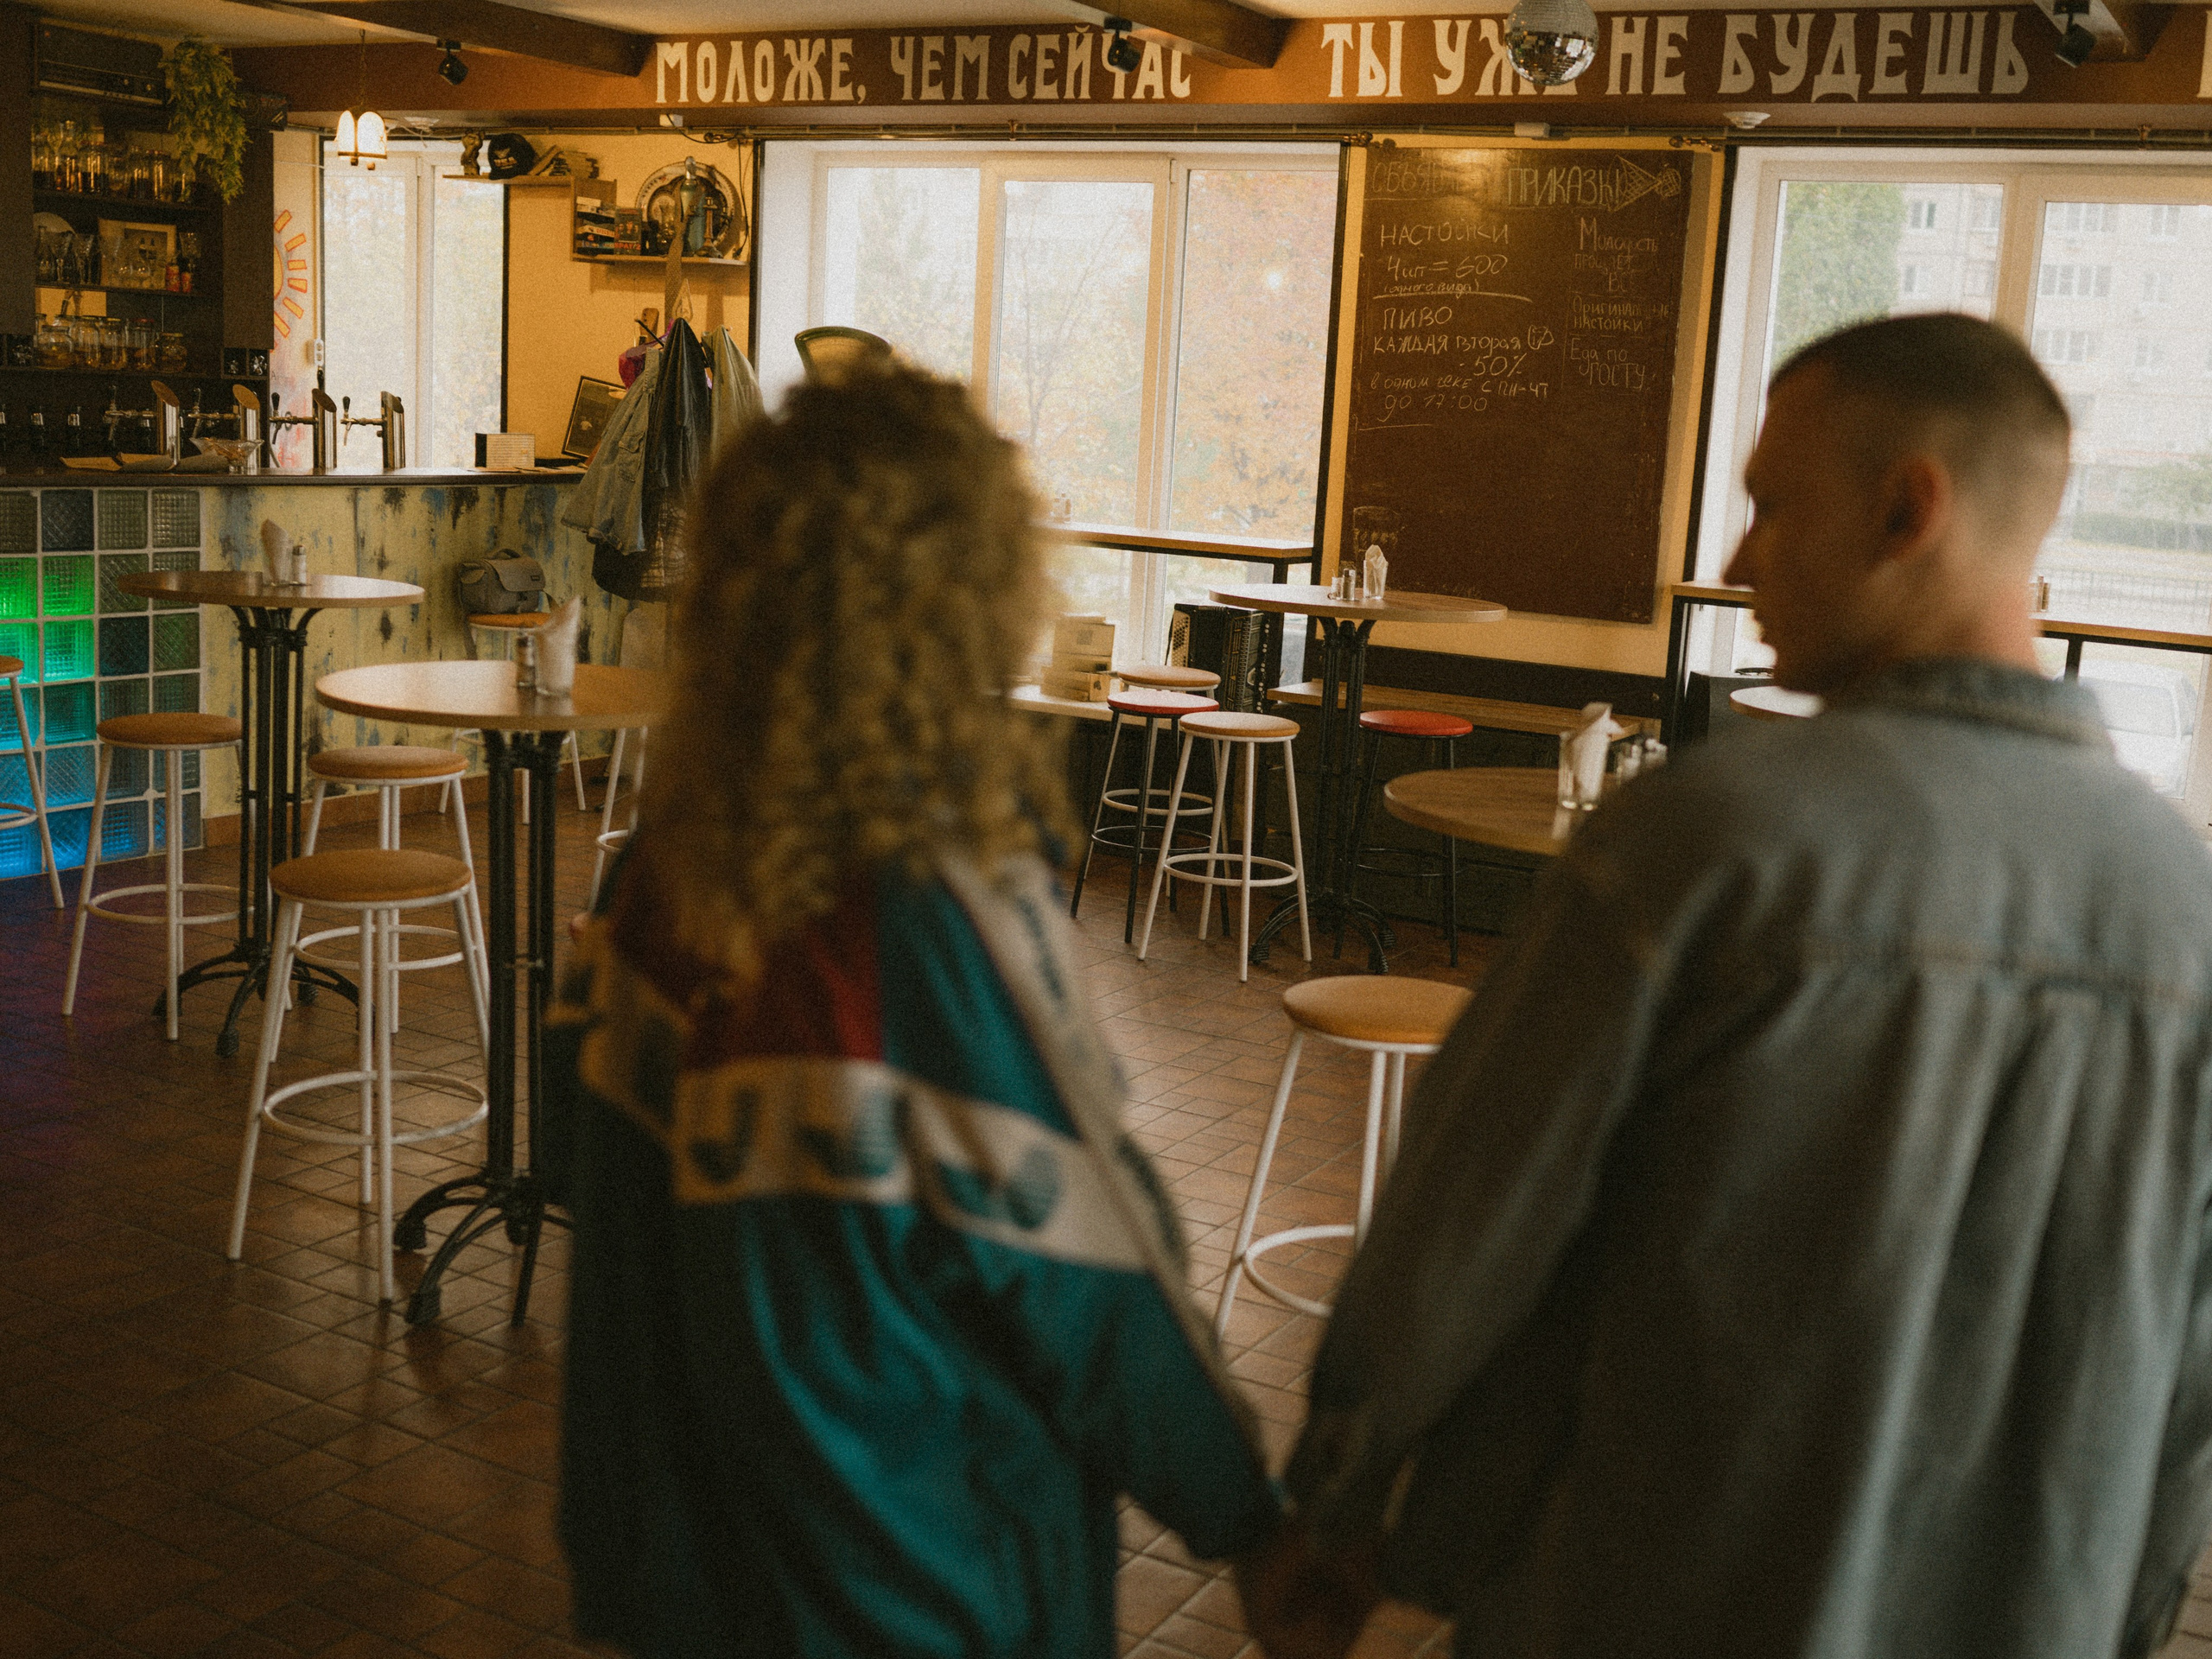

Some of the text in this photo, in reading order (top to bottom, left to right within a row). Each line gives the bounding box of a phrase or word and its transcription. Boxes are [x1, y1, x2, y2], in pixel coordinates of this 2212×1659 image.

[655, 24, 1192, 104] МОЛОЖЕ, ЧЕМ СЕЙЧАС
[1321, 11, 2029, 103] ТЫ УЖ НЕ БУДЕШЬ
[1383, 306, 1452, 331] ПИВО
[1423, 393, 1488, 411] 17:00
